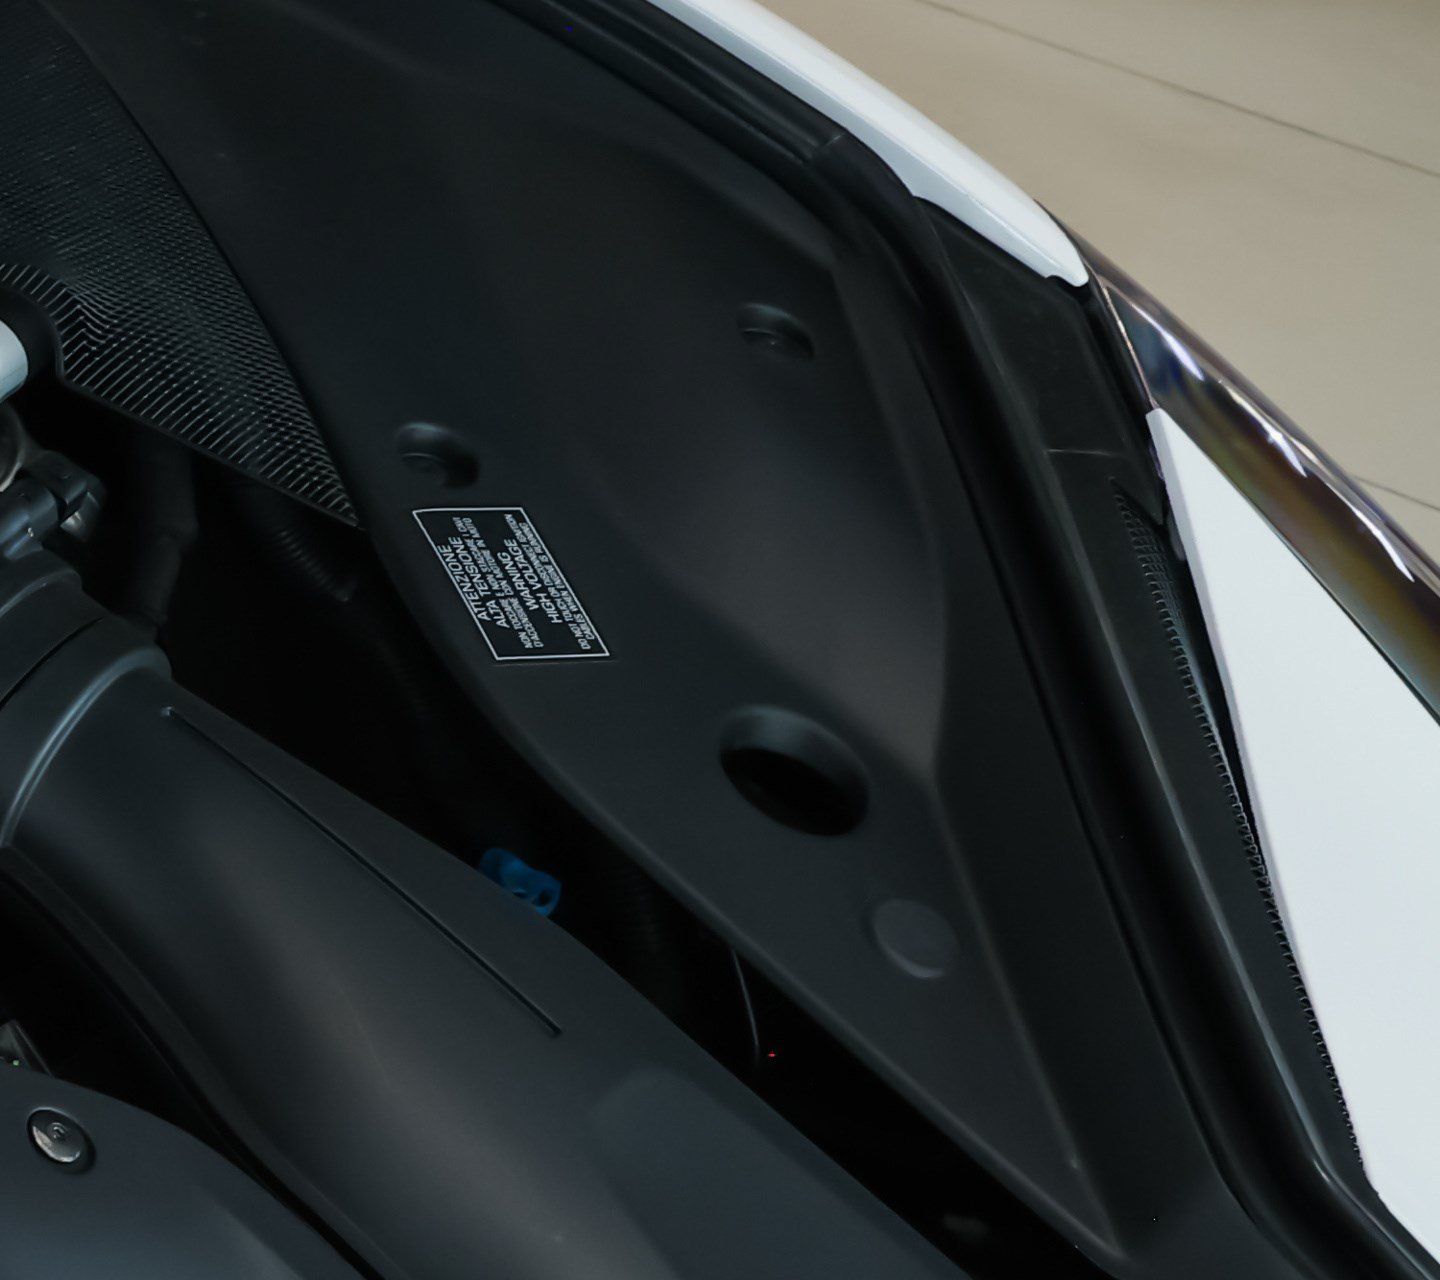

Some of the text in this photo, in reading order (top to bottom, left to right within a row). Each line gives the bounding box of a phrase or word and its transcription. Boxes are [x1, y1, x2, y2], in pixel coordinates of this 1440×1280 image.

[462, 517, 480, 538] MOTO
[438, 545, 490, 621] ATTENZIONE
[448, 537, 510, 628] ALTA TENSIONE
[497, 552, 539, 610] WARNING
[504, 539, 563, 623] HIGH VOLTAGE
